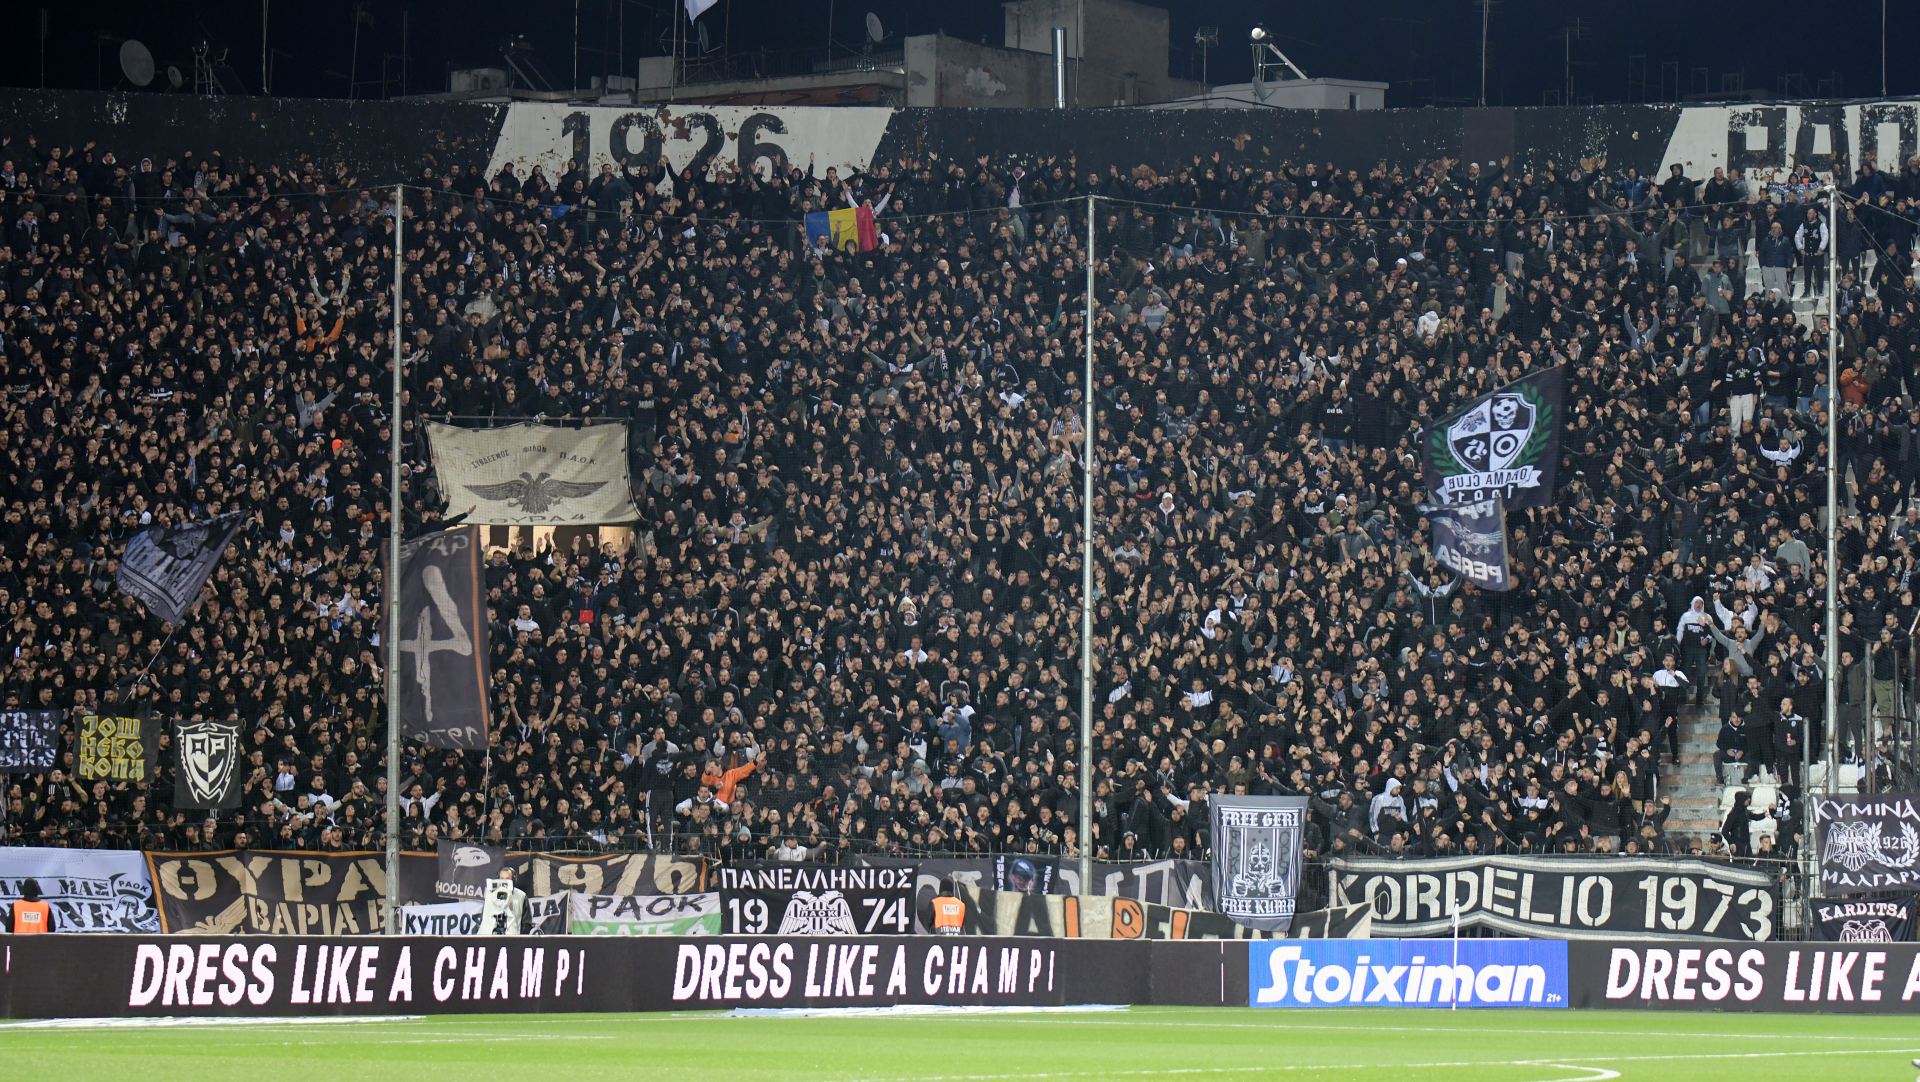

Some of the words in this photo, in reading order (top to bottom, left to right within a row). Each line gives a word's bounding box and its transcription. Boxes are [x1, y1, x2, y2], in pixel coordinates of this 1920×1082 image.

[562, 111, 789, 186] 1926
[1222, 811, 1258, 826] FREE
[1262, 812, 1298, 827] GERI
[436, 880, 485, 898] HOOLIGA
[728, 897, 769, 933] 19
[863, 897, 909, 933] 74
[1222, 899, 1253, 913] FREE
[1328, 866, 1613, 927] KORDELIO
[1638, 874, 1772, 941] 1973
[1819, 902, 1908, 923] KARDITSA
[129, 944, 277, 1006] DRESS
[290, 944, 380, 1003] LIKE
[389, 945, 413, 1002] A
[672, 943, 794, 1000] DRESS
[804, 943, 879, 997] LIKE
[887, 944, 907, 996] A
[1257, 945, 1546, 1003] Stoiximan
[1606, 947, 1765, 1001] DRESS
[1783, 950, 1887, 1001] LIKE
